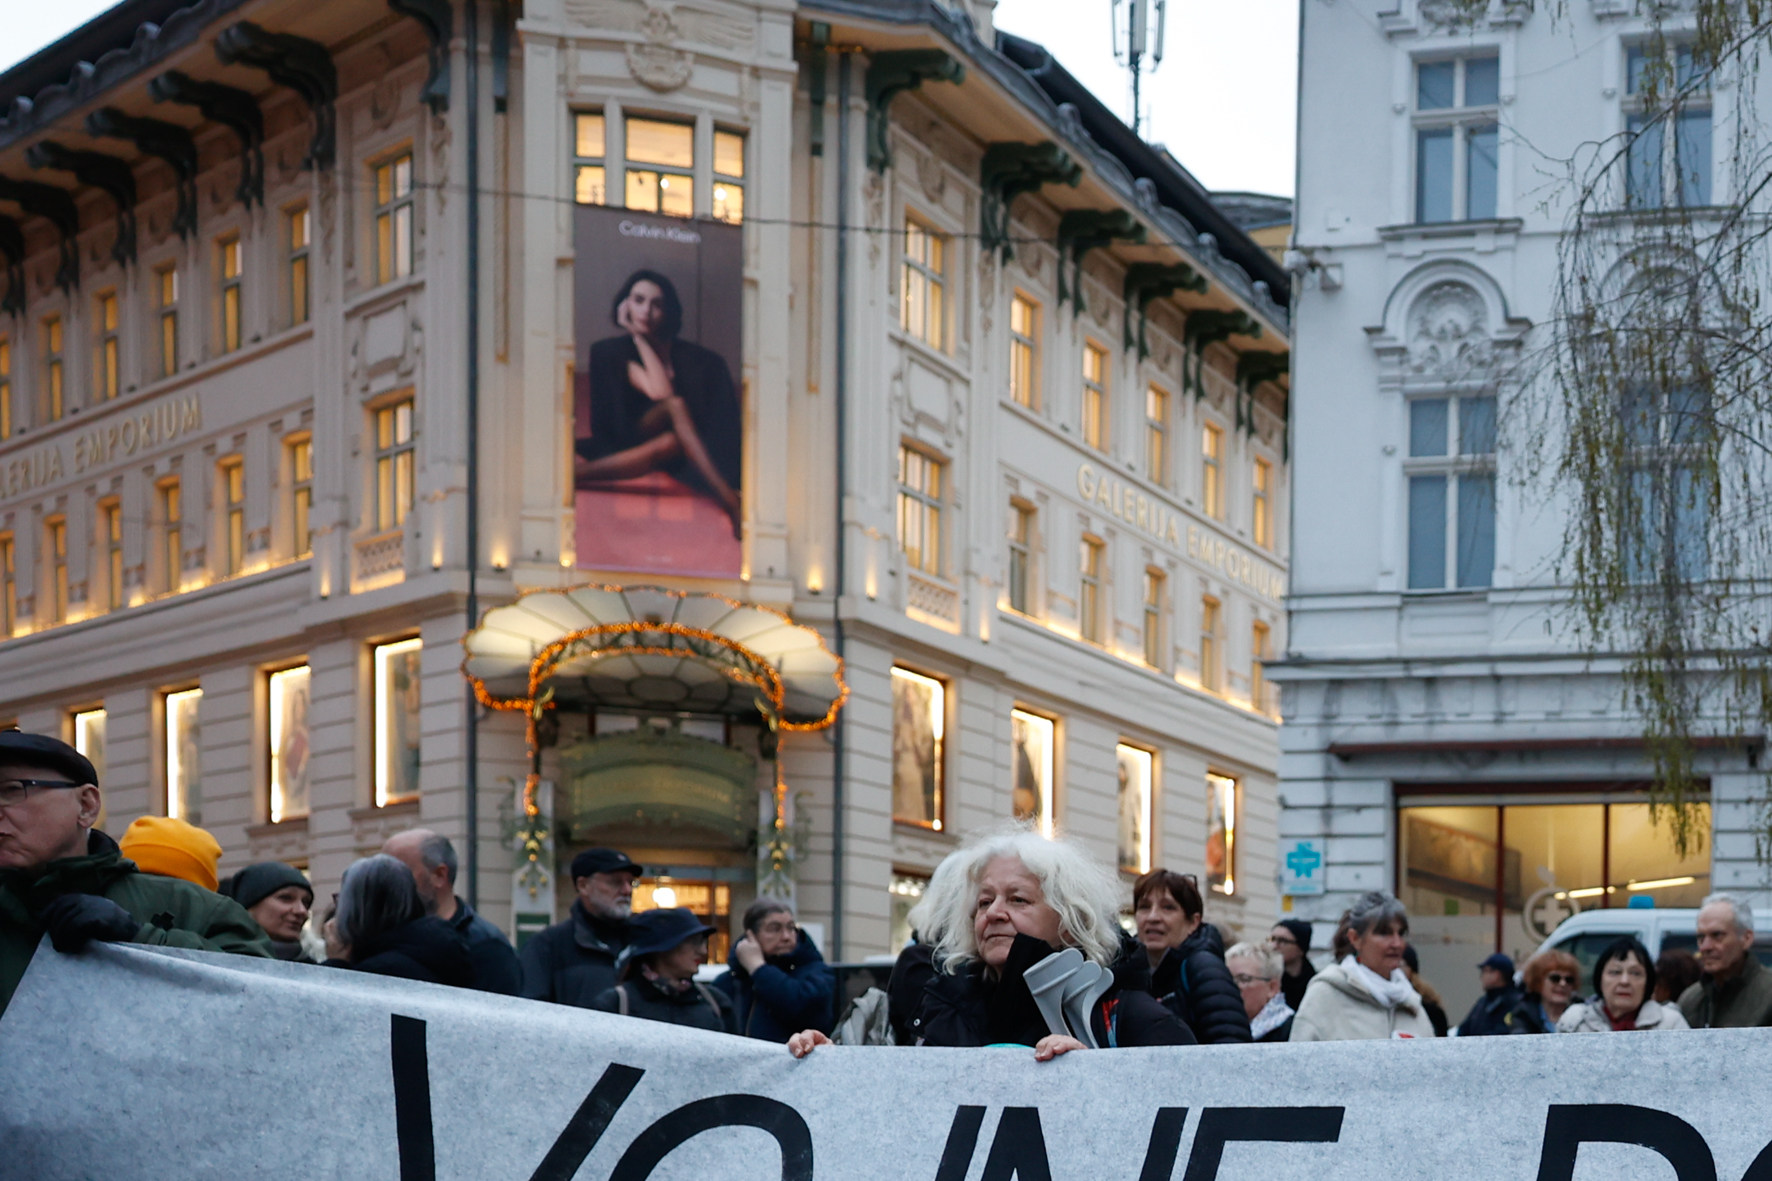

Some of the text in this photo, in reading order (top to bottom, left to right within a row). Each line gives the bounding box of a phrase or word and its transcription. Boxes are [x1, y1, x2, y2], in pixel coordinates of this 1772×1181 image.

[75, 393, 201, 474] EMPORIUM
[1077, 463, 1284, 602] GALERIJA EMPORIUM
